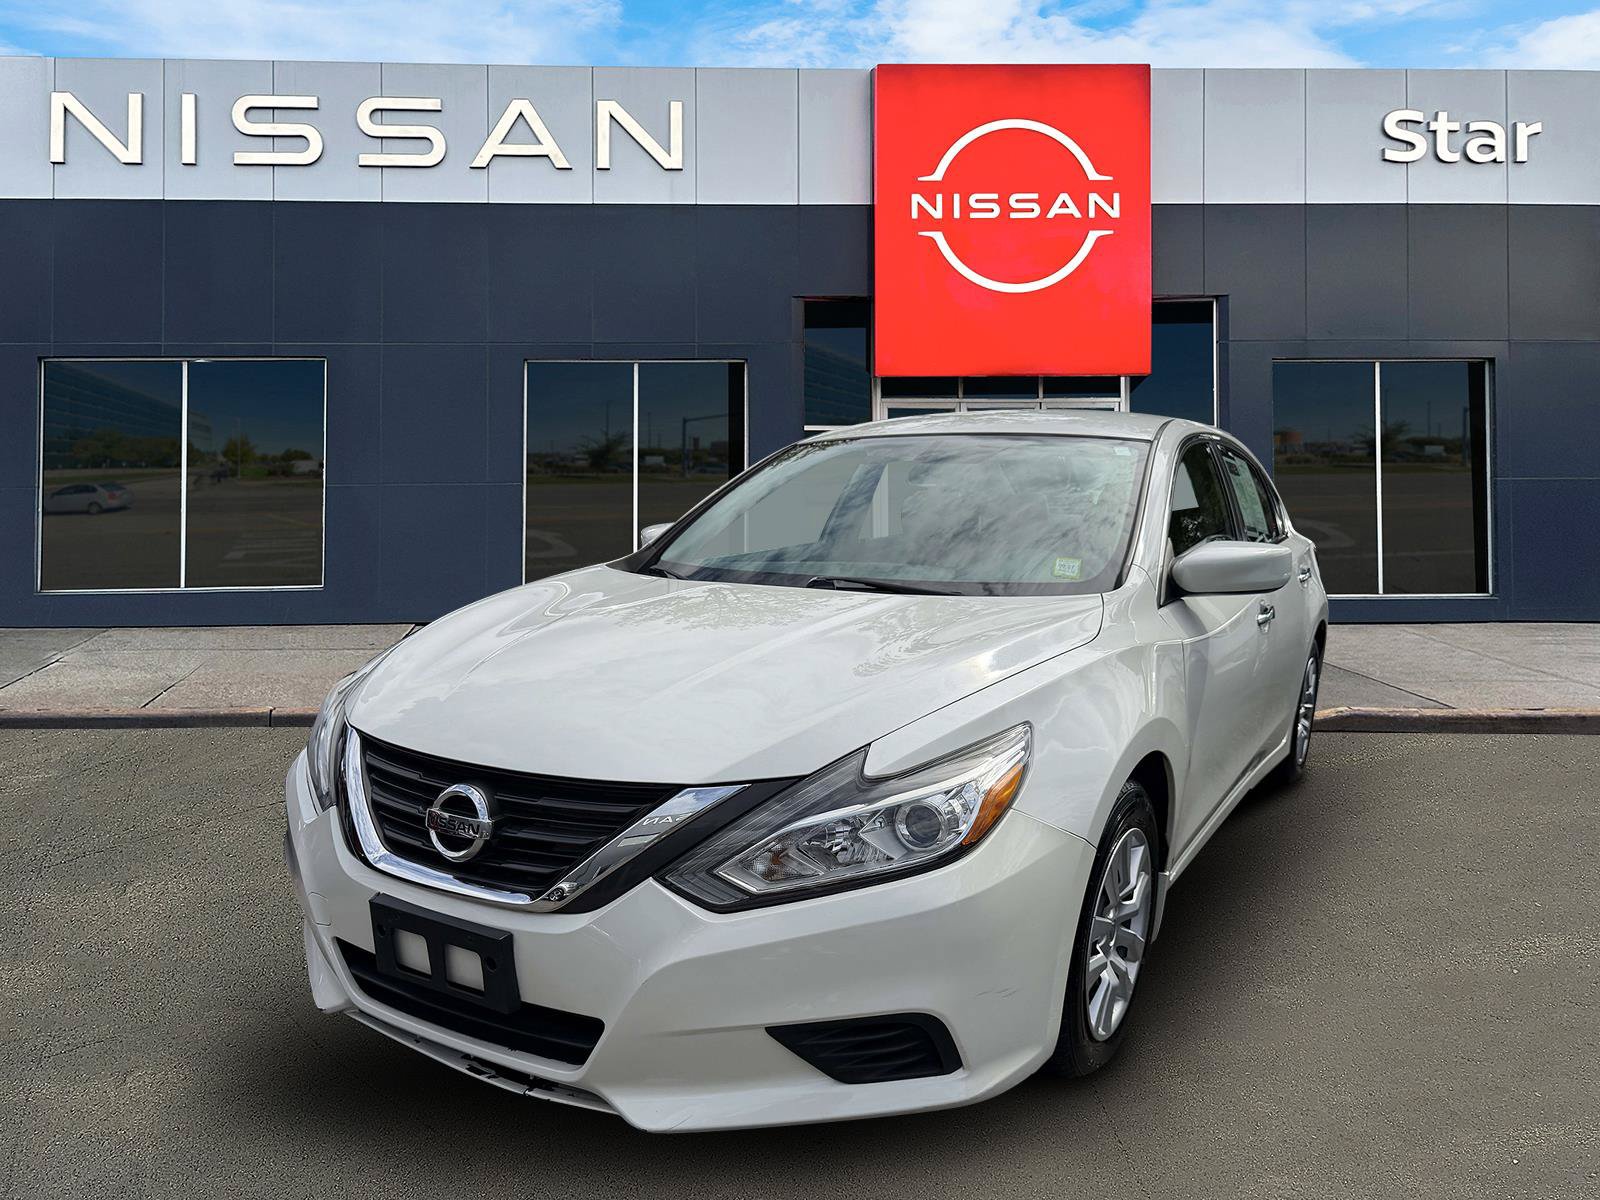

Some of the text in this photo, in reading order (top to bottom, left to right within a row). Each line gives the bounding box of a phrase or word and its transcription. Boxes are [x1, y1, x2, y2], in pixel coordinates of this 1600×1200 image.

[50, 91, 683, 170] NISSAN
[1382, 109, 1542, 163] Star
[911, 192, 1120, 219] NISSAN
